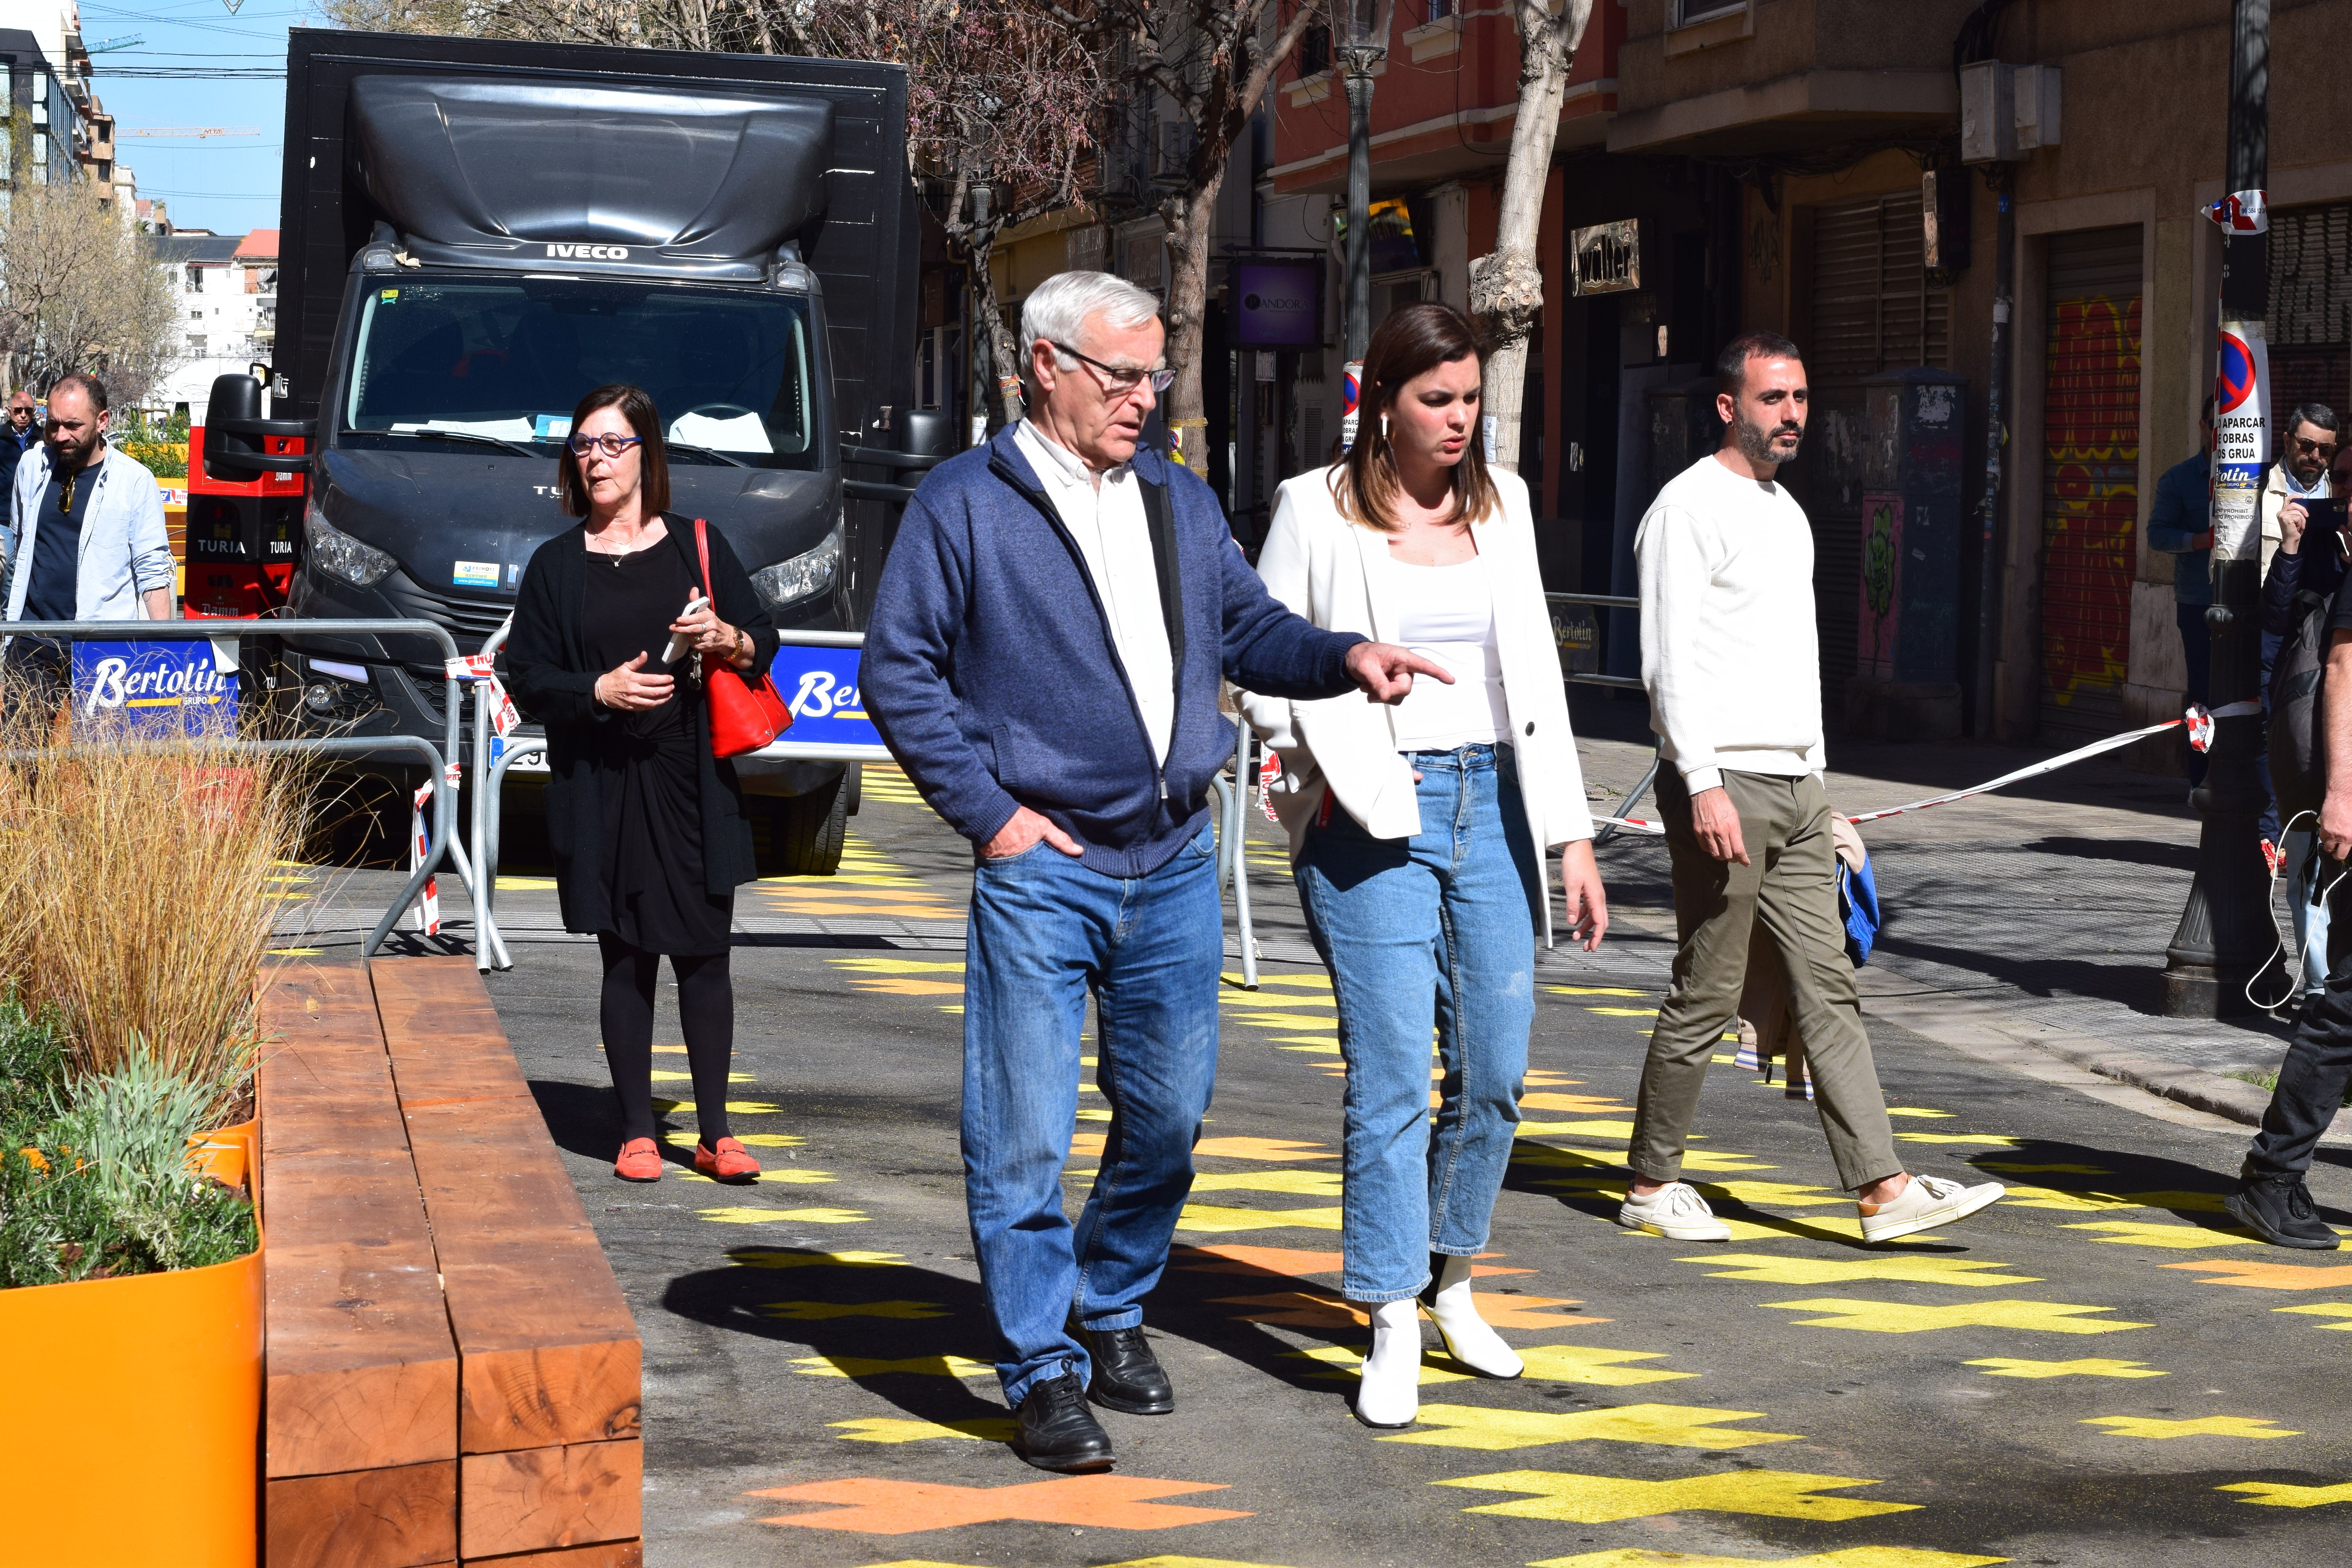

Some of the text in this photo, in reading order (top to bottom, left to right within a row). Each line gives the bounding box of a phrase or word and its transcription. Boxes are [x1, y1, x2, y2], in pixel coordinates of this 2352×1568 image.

[547, 244, 628, 260] IVECO
[1579, 234, 1631, 283] walter
[1250, 297, 1309, 309] PANDORA
[2223, 417, 2265, 428] APARCAR
[2223, 433, 2254, 443] OBRAS
[2229, 448, 2255, 459] GRUA
[2218, 468, 2249, 482] tolín
[198, 539, 245, 554] TURIA
[270, 541, 292, 554] TURIA
[200, 603, 238, 617] Damm
